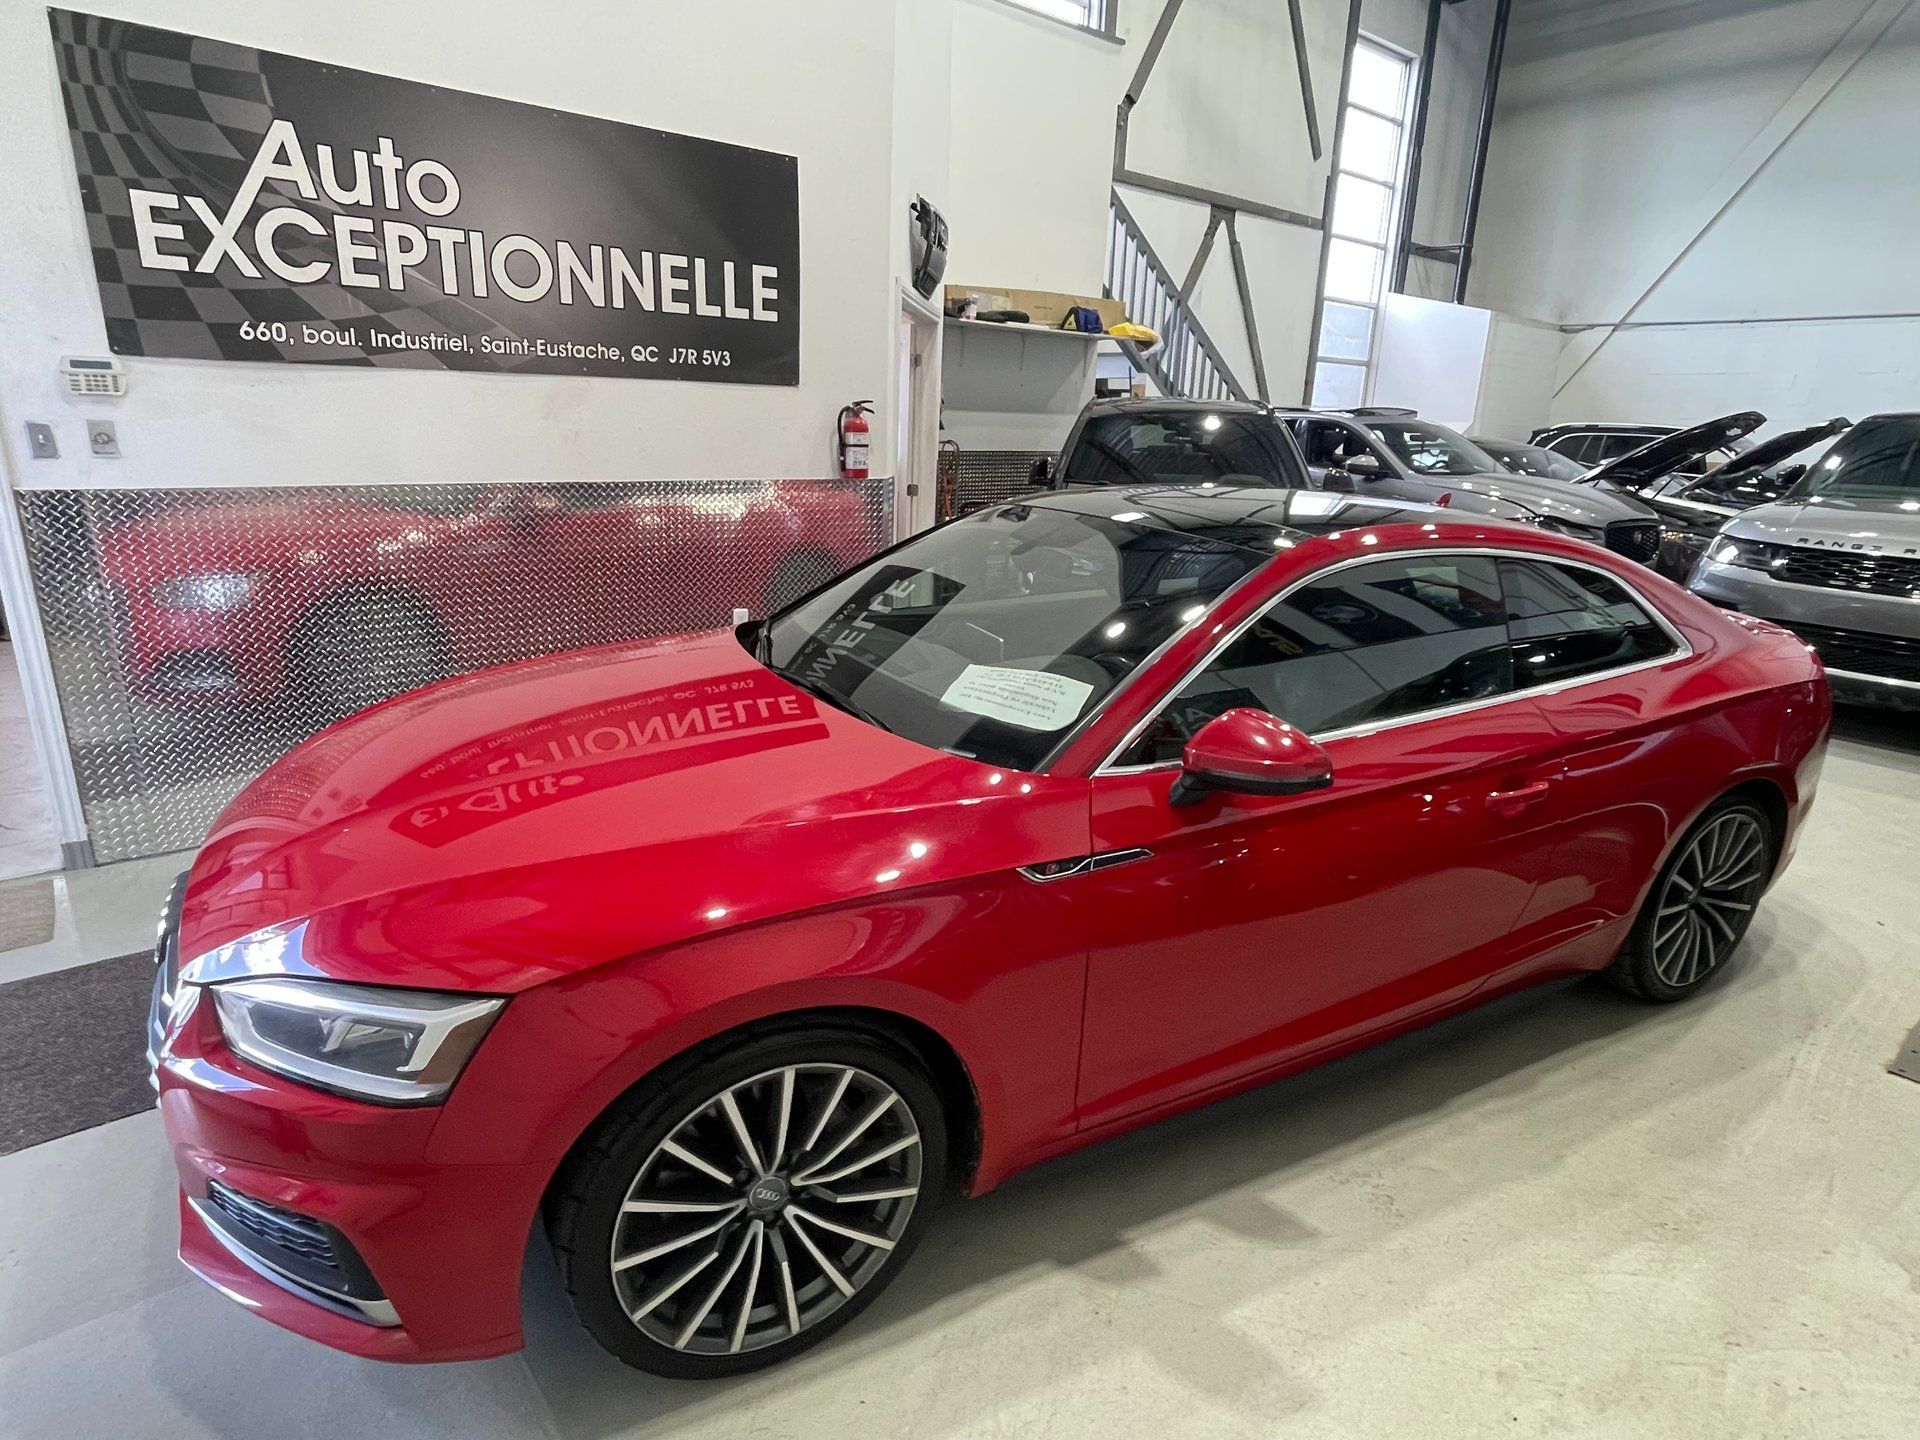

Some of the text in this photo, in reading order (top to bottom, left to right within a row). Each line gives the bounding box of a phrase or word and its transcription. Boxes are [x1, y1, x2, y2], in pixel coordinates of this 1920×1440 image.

[237, 119, 461, 217] Auto
[128, 188, 779, 322] EXCEPTIONNELLE
[239, 320, 732, 367] 660, boul. Industriel, Saint-Eustache, QC J7R 5V3
